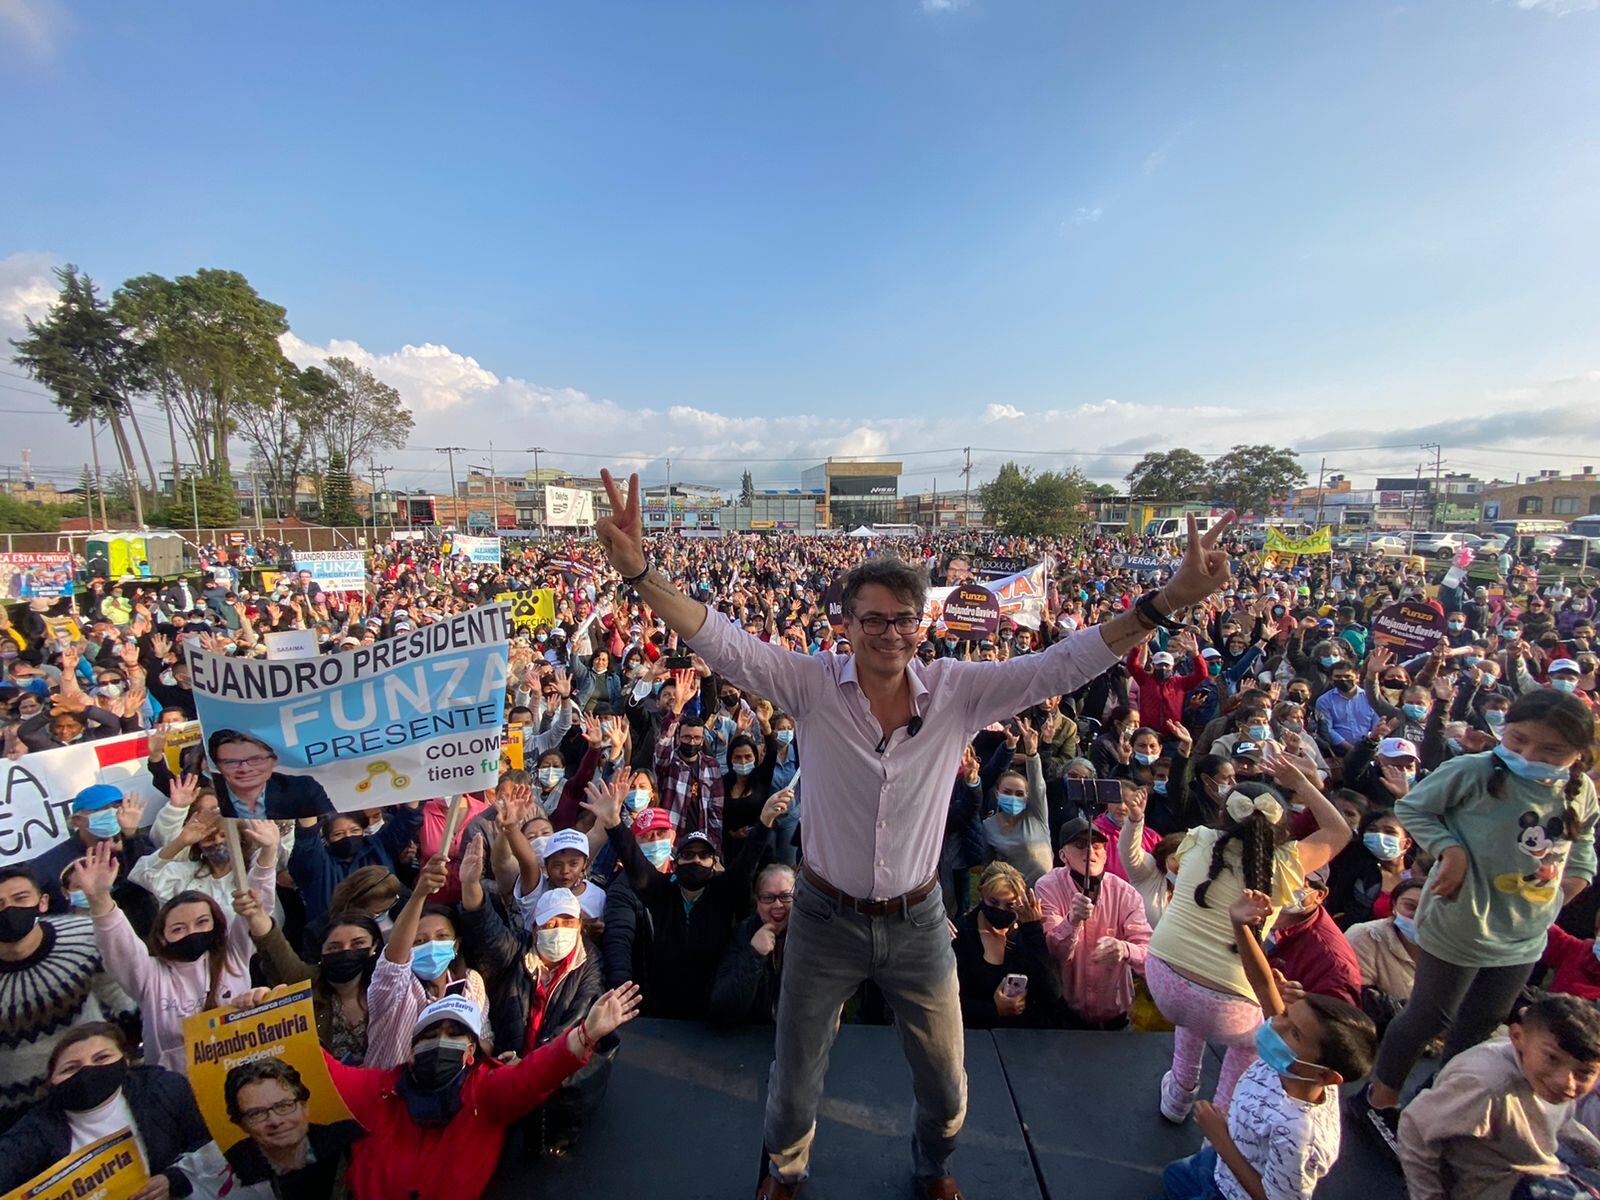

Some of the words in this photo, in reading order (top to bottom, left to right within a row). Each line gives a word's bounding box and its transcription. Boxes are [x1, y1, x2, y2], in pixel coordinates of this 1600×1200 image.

[313, 561, 365, 573] FUNZA
[960, 591, 987, 601] Funza
[945, 603, 975, 616] Alejandro
[976, 606, 998, 619] Gaviria
[957, 615, 986, 623] Presidente
[1400, 606, 1433, 621] Funza
[1378, 615, 1415, 633] Alejandro
[1414, 625, 1442, 639] Gaviria
[1390, 629, 1425, 642] Presidente
[190, 650, 343, 699] EJANDRO
[353, 605, 513, 678] PRESIDENTE
[279, 651, 507, 748] FUNZA
[305, 704, 498, 765] PRESENTE
[428, 764, 475, 782] tiene
[194, 1030, 257, 1065] Alejandro
[257, 1014, 308, 1045] Gaviria
[223, 1044, 286, 1070] Presidente
[71, 1150, 133, 1198] Gaviria
